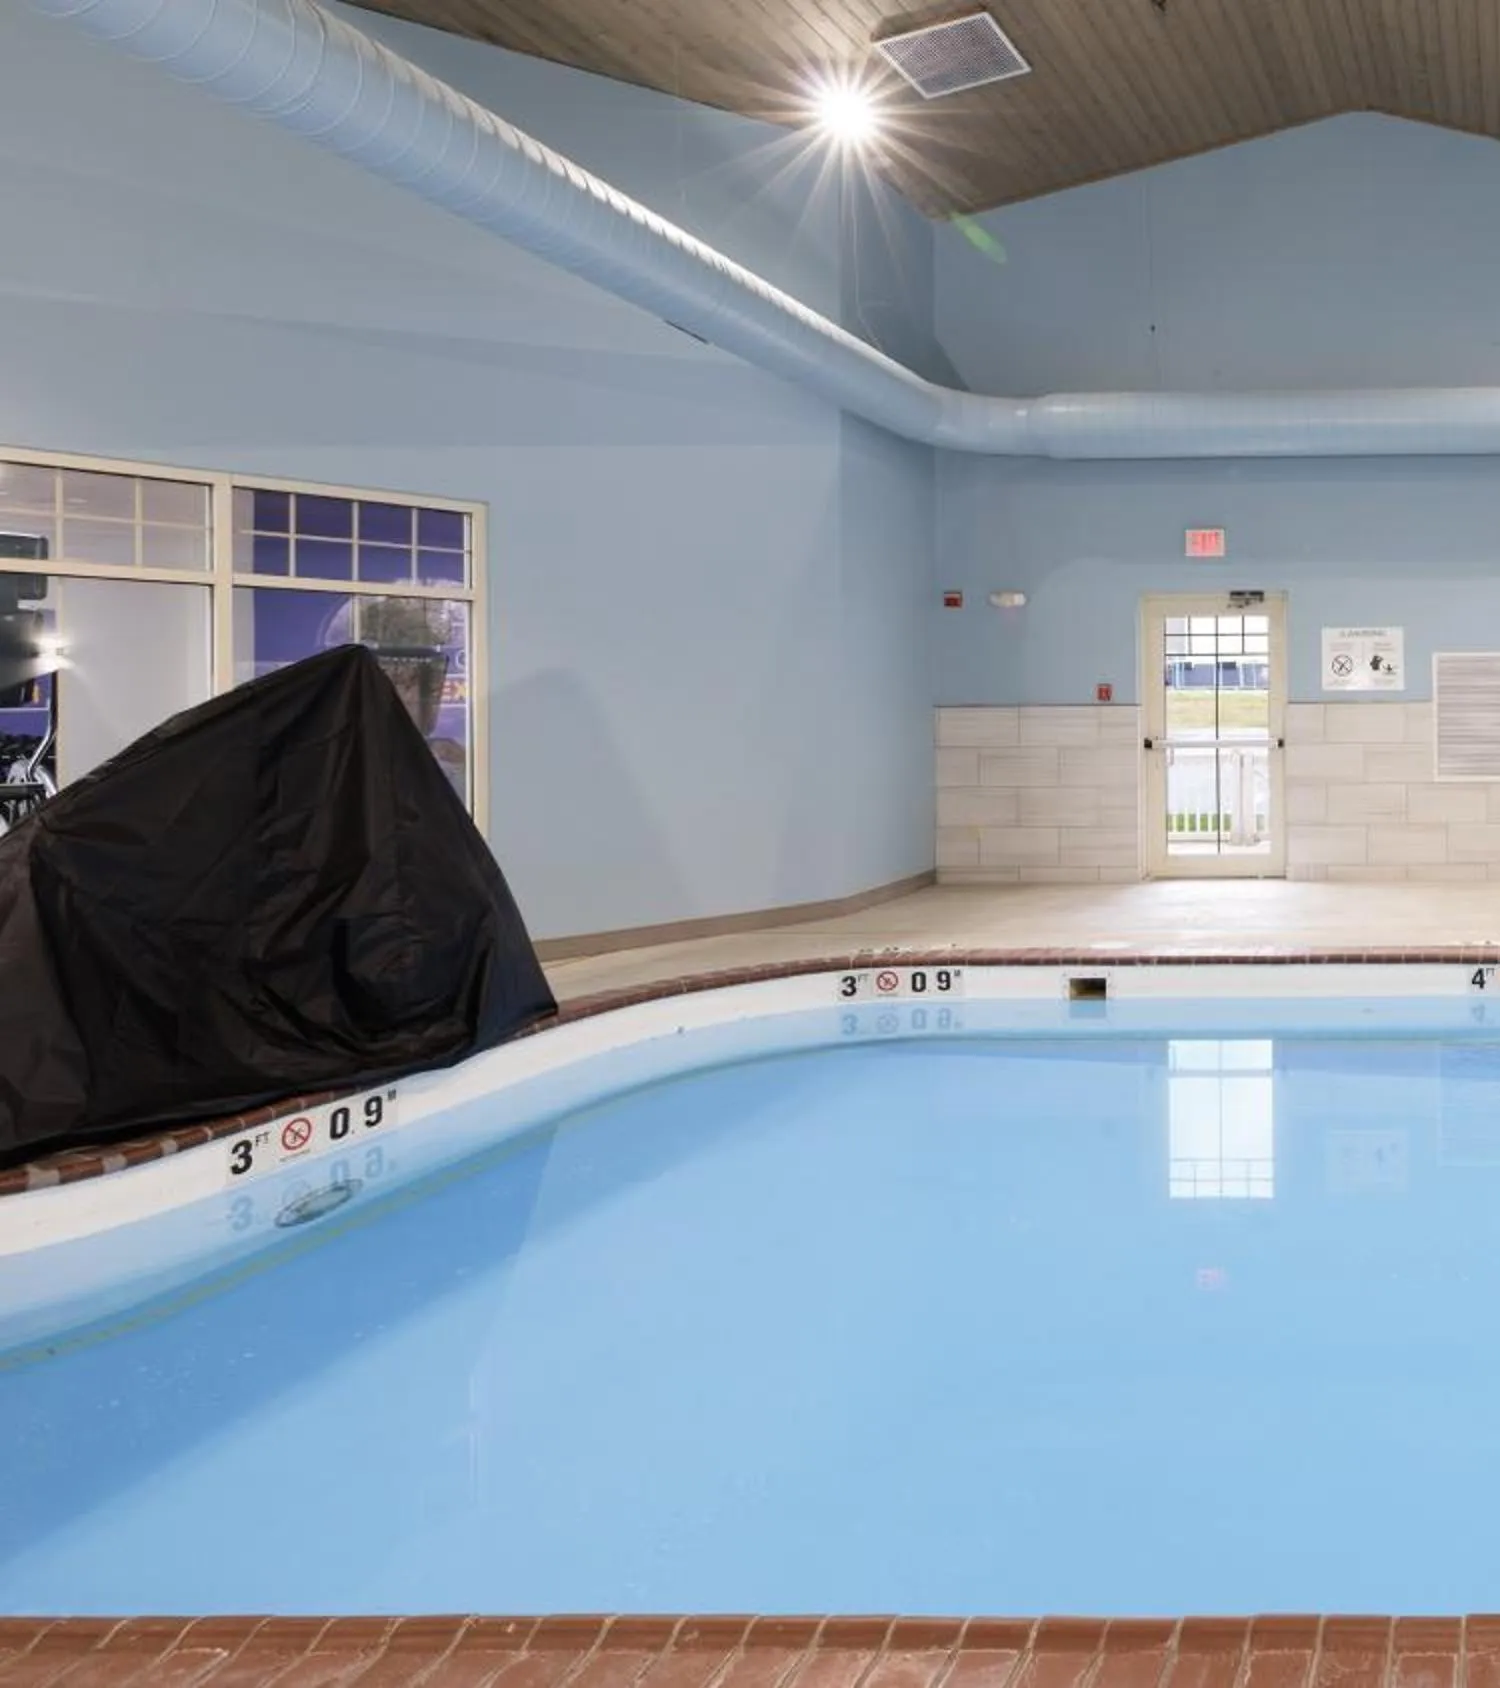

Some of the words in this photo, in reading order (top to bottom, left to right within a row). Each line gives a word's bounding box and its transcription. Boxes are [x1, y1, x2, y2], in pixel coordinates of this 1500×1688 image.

[841, 975, 857, 997] 3
[1471, 967, 1486, 989] 4
[231, 1140, 252, 1175] 3
